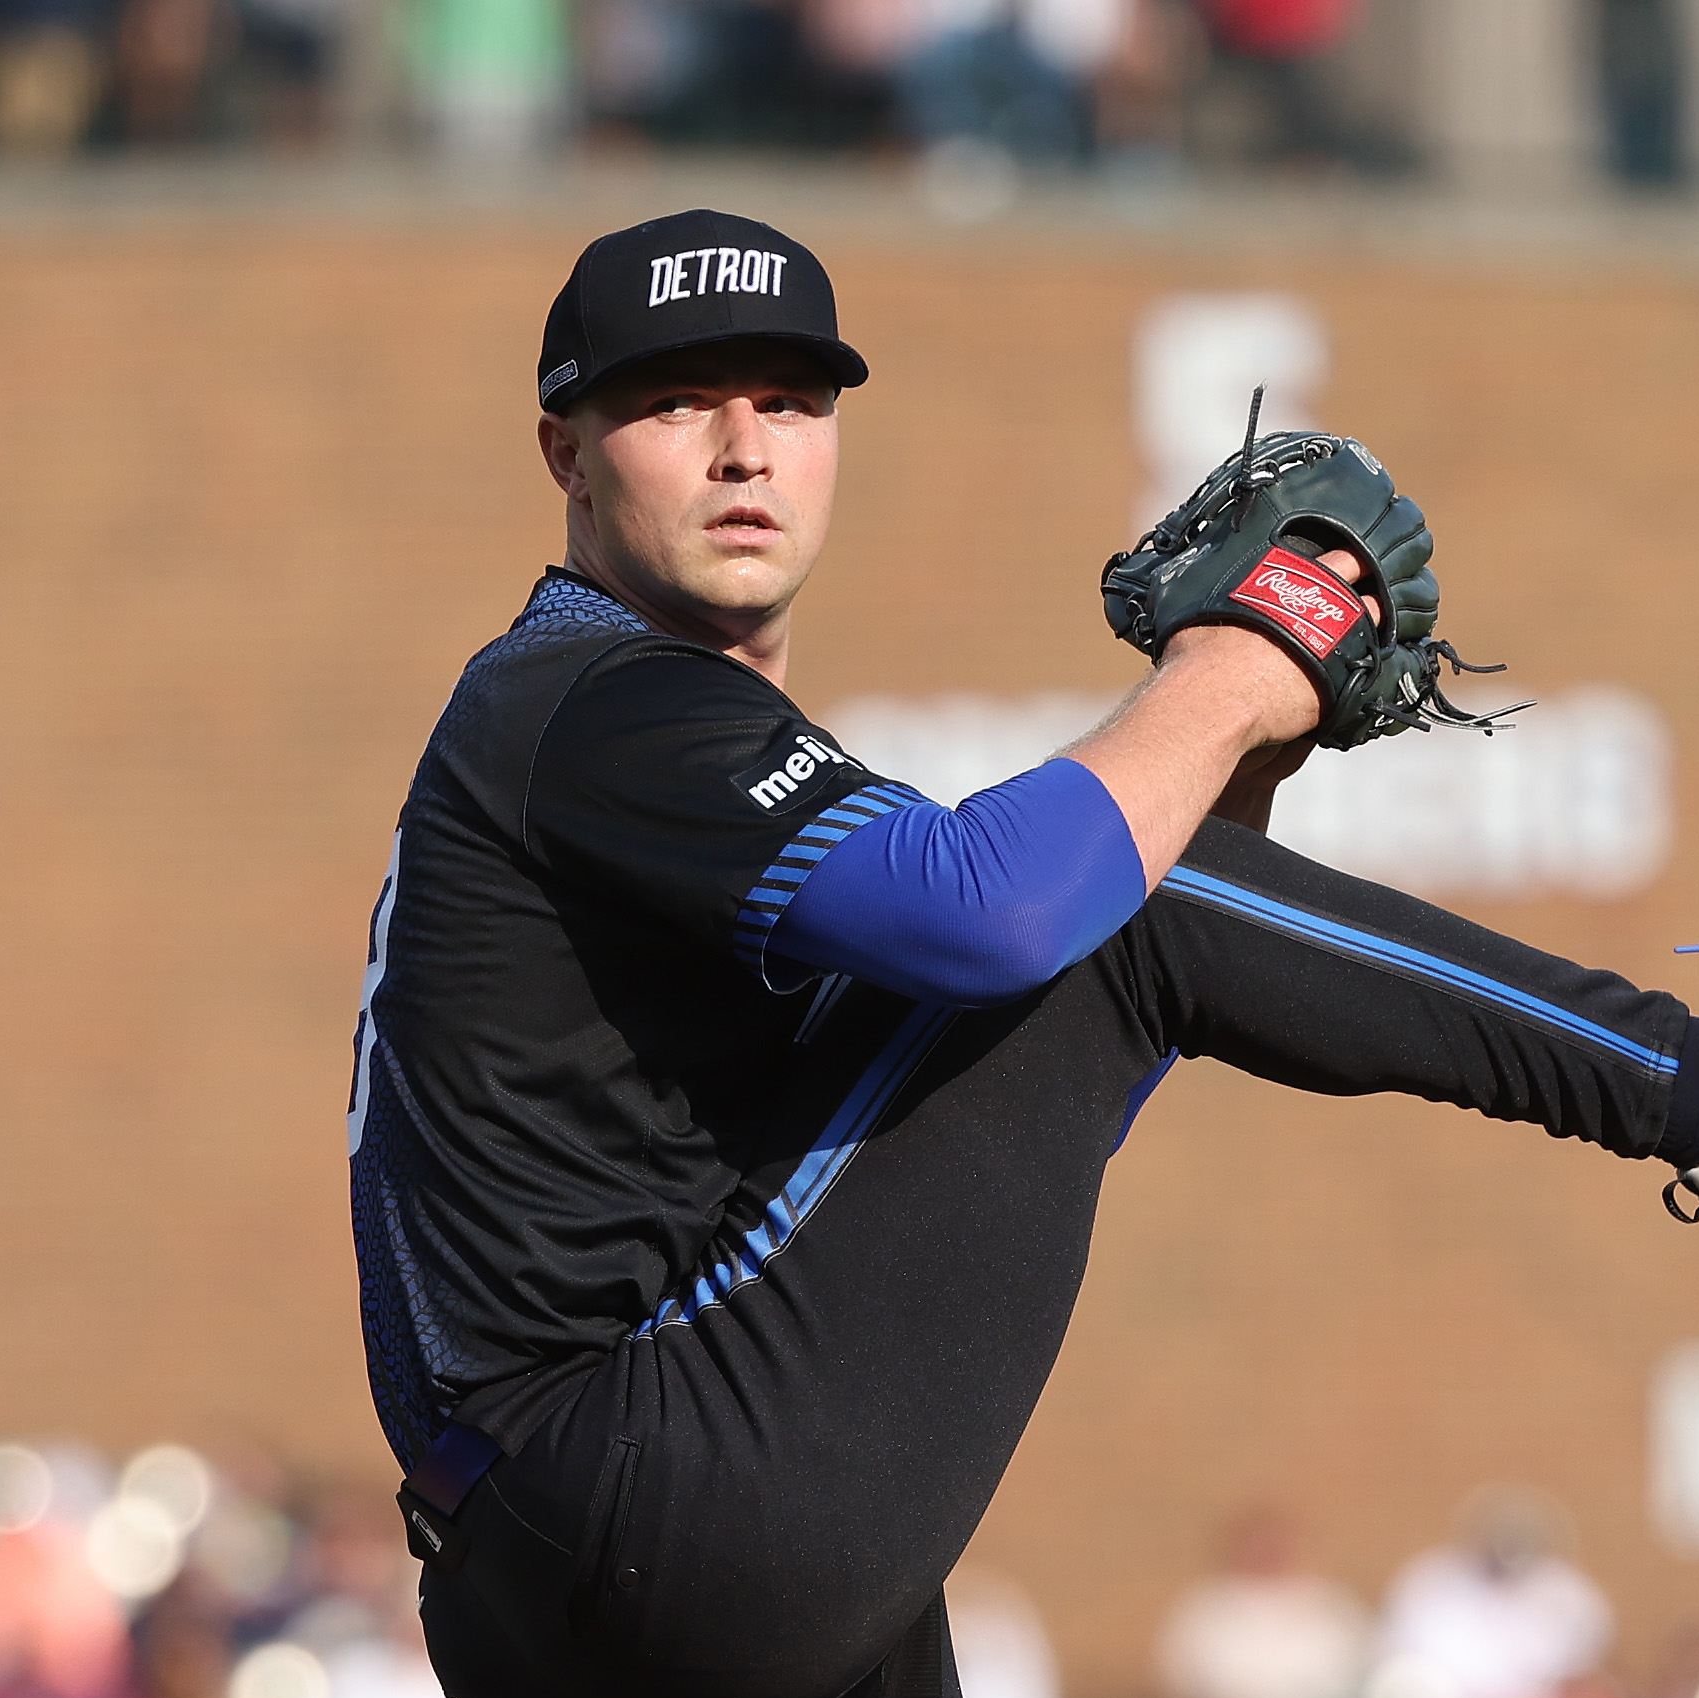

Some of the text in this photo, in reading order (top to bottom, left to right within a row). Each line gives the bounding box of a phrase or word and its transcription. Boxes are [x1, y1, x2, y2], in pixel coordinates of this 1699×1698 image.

[648, 246, 788, 308] DETROIT
[1255, 569, 1345, 622] Rawlings
[748, 735, 863, 809] meij
